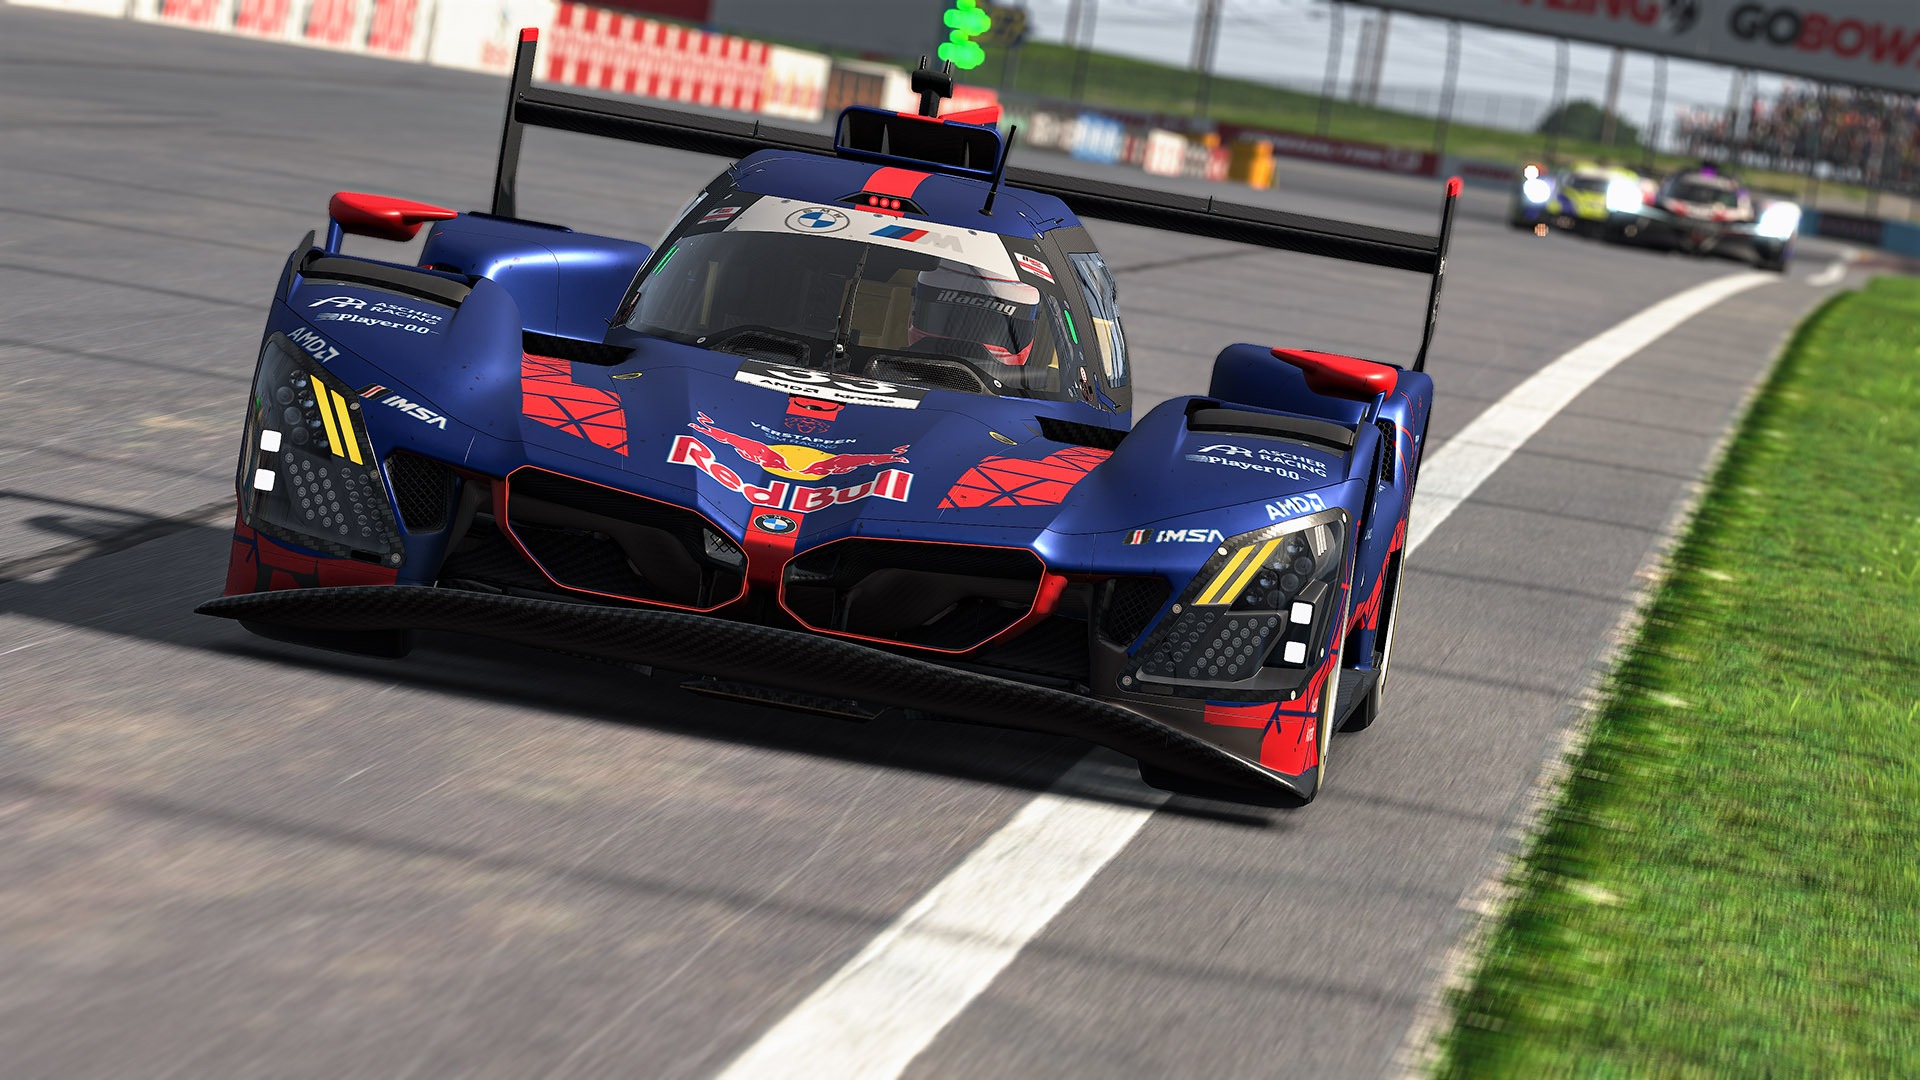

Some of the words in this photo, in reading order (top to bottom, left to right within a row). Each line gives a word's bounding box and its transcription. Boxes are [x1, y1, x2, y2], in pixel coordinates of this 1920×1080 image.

[1727, 3, 1920, 69] GOBOW
[374, 302, 443, 321] ASCHER
[936, 289, 1017, 316] iRacing
[370, 307, 438, 325] RACING
[766, 364, 899, 394] 33
[381, 395, 448, 430] IMSA
[750, 421, 857, 444] VERSTAPPEN
[789, 437, 838, 450] RACING
[1258, 448, 1327, 470] ASCHER
[1260, 455, 1327, 478] RACING
[667, 434, 790, 508] Red
[789, 468, 914, 513] Bull
[1155, 529, 1225, 543] IMSA
